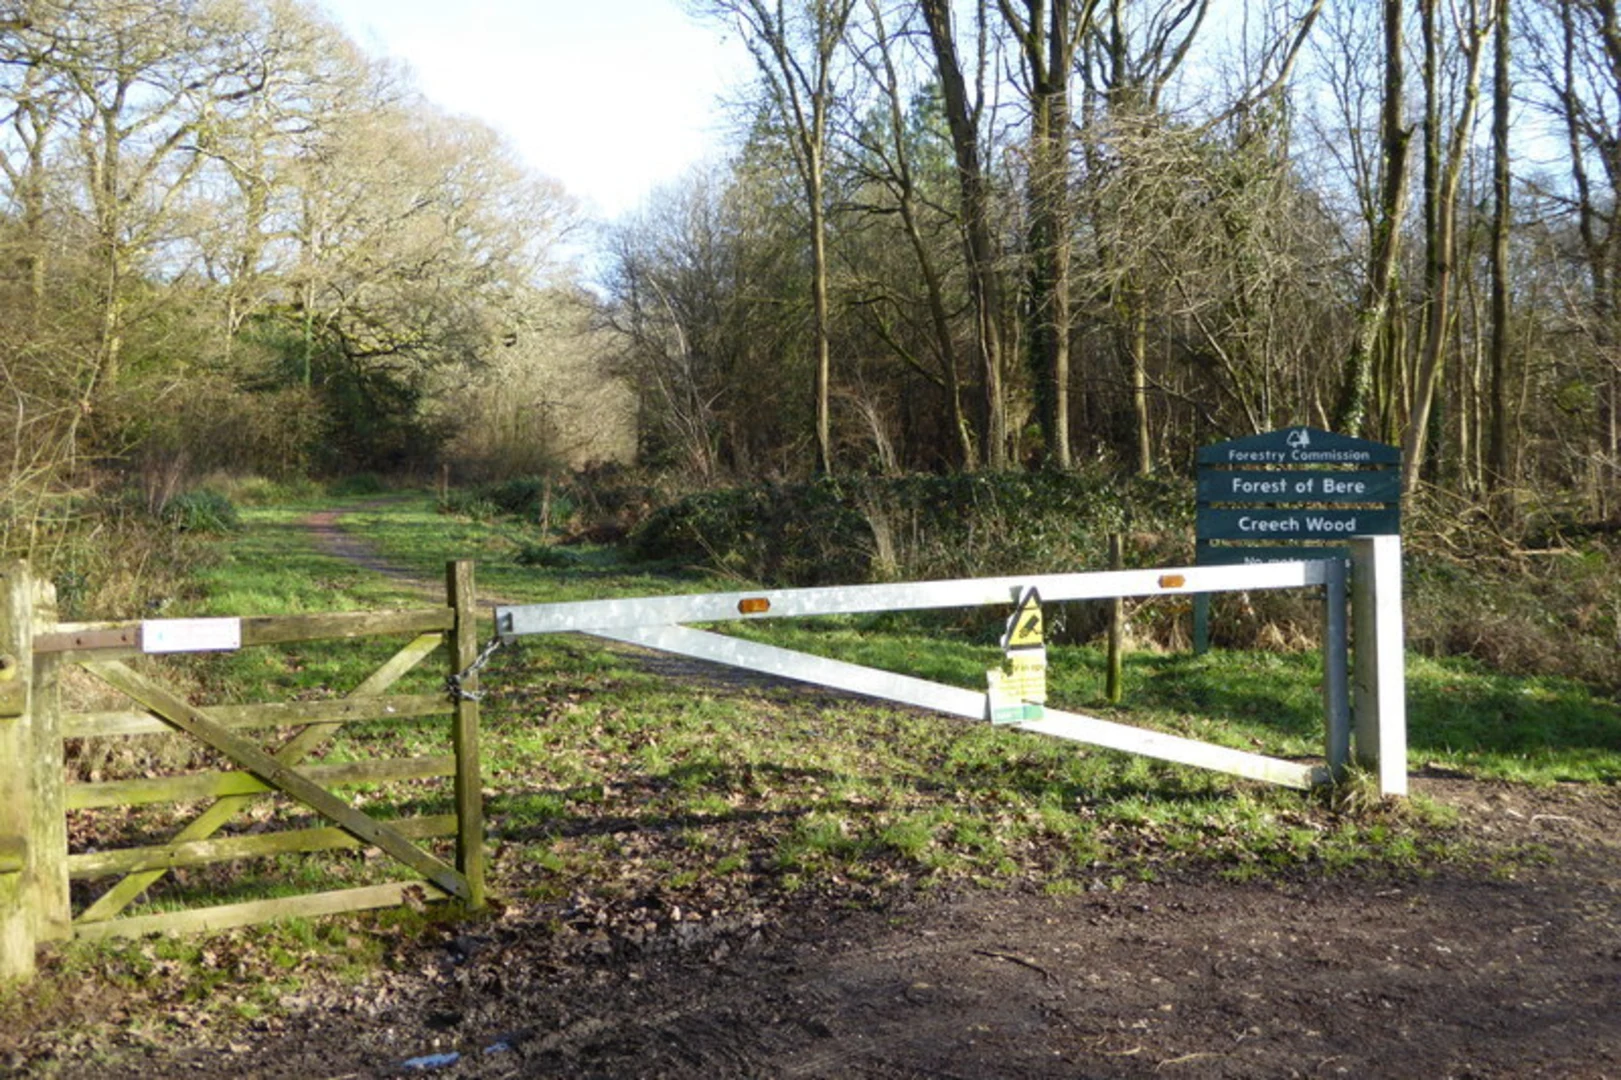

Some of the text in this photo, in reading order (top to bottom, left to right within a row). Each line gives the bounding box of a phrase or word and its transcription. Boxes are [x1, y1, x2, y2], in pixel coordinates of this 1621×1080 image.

[1228, 449, 1370, 463] Forestry Commission
[1232, 477, 1366, 493] Forest of Bere
[1238, 516, 1356, 531] Creech Wood
